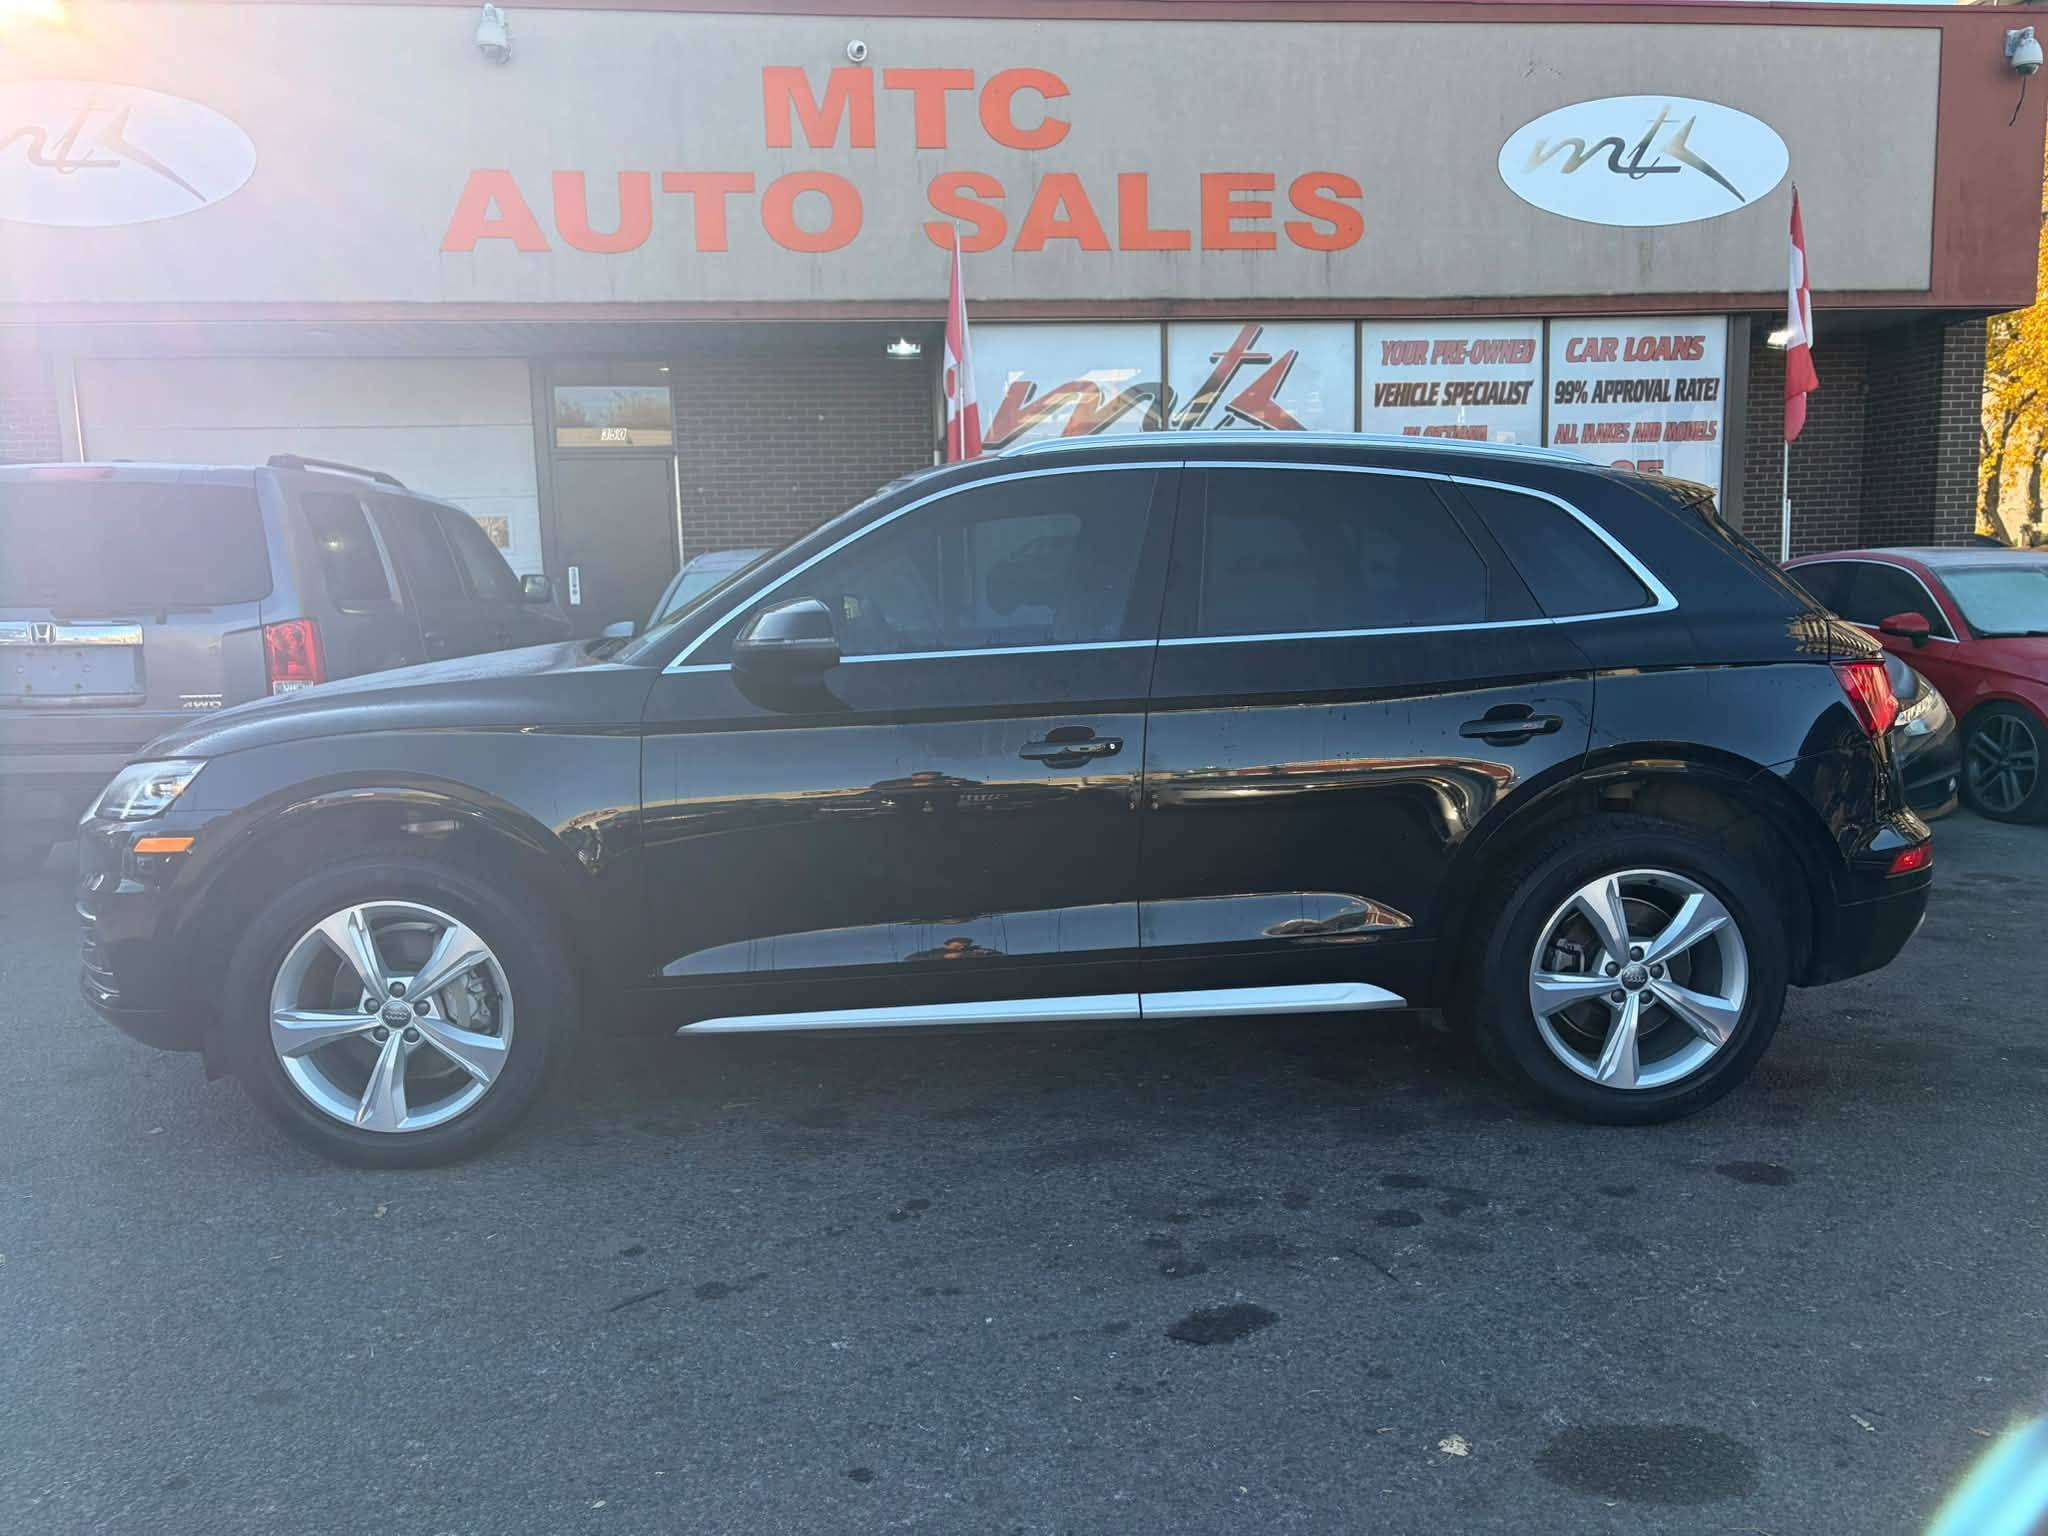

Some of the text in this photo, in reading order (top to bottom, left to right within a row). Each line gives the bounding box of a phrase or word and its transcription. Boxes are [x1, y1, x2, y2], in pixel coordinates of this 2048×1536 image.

[762, 66, 1072, 150] MTC
[439, 168, 1364, 254] AUTO SALES
[1381, 339, 1536, 366] YOUR PRE-OWNED
[1565, 335, 1706, 363] CAR LOANS
[1374, 380, 1534, 407] VEHICLE SPECIALIST
[1554, 377, 1720, 404] 99% APPROVAL RATE!
[1553, 420, 1718, 445] ALL MAKES AND MODELS
